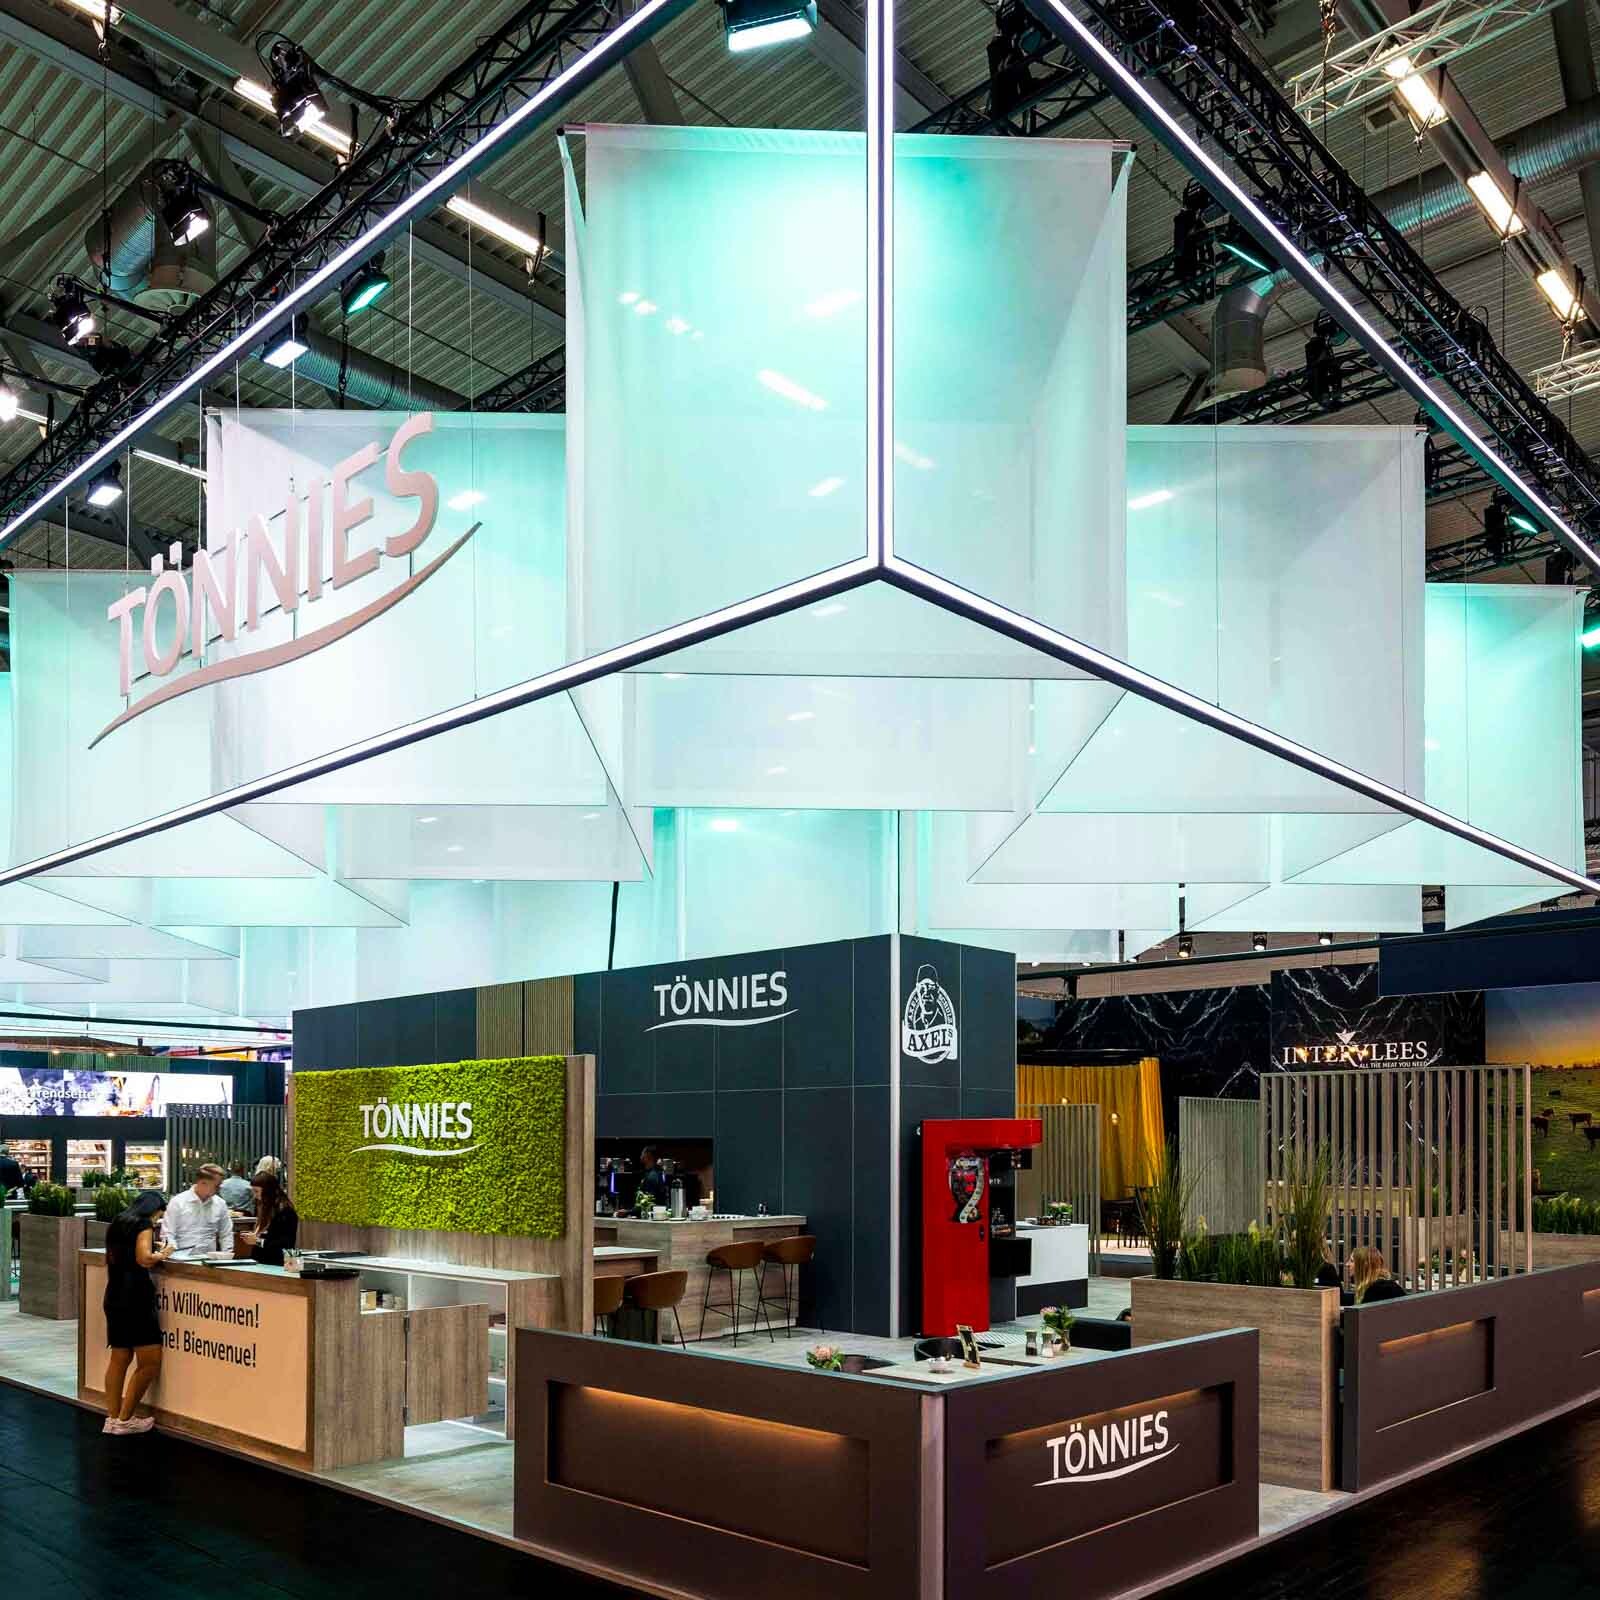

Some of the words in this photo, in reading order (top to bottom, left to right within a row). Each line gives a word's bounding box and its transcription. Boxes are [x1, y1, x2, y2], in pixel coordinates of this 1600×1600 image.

[107, 411, 439, 697] TÖNNIES
[653, 971, 788, 1017] TÖNNIES
[1282, 1041, 1428, 1067] INTERVLEES
[359, 1096, 473, 1140] TÖNNIES
[172, 1290, 260, 1329] Willkommen!
[183, 1329, 257, 1368] Bienvenue!
[1046, 1410, 1169, 1479] TÖNNIES
